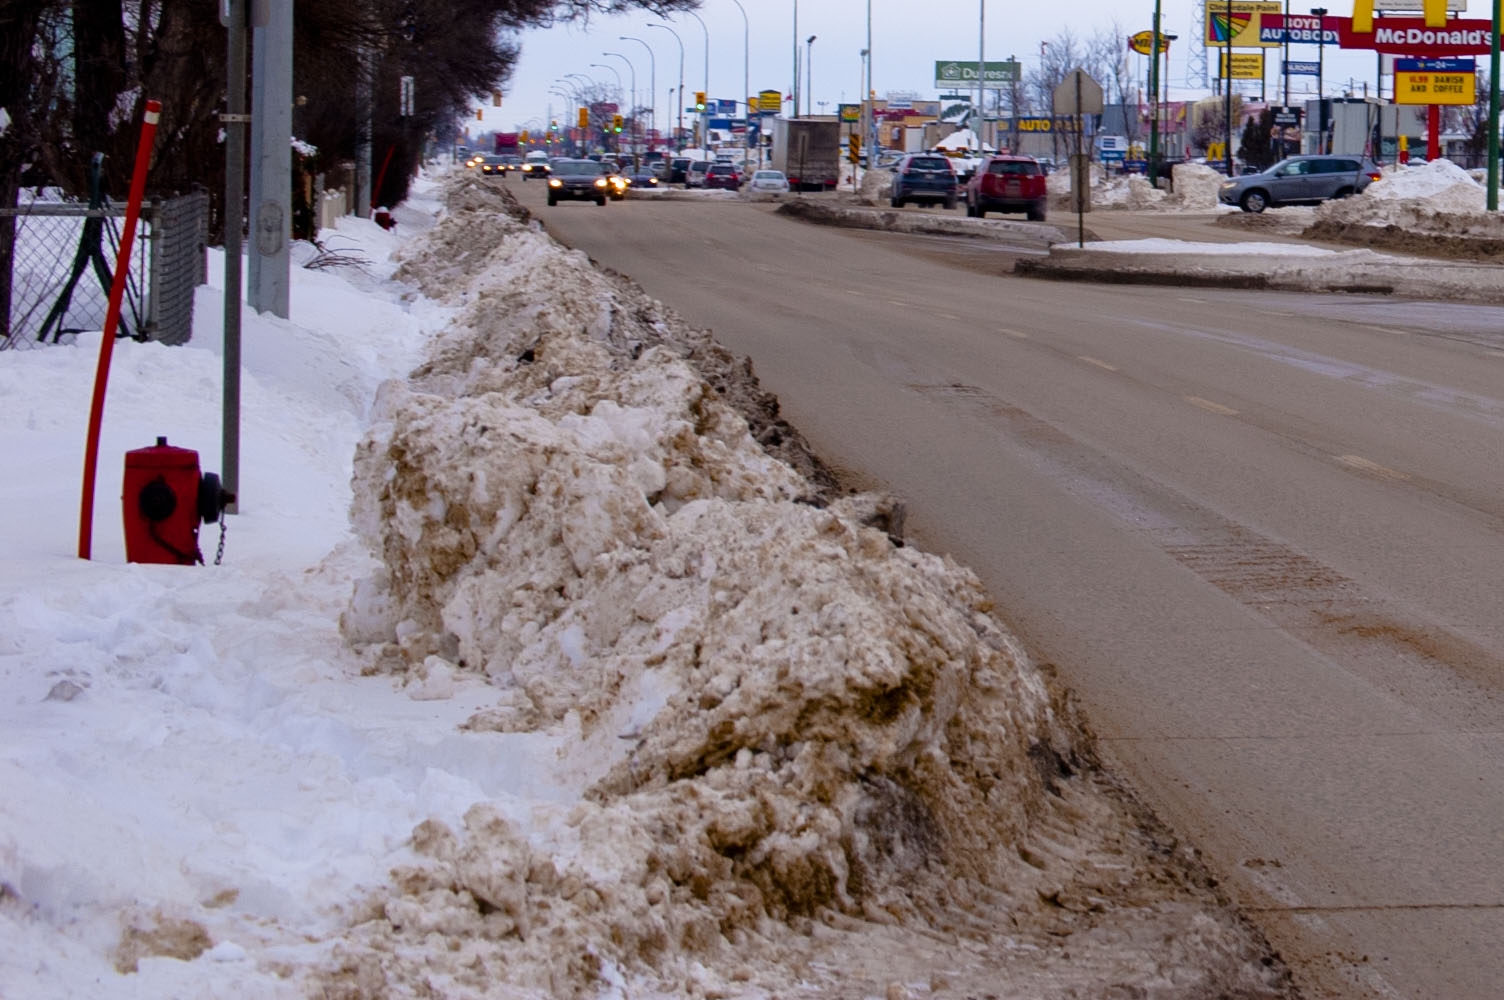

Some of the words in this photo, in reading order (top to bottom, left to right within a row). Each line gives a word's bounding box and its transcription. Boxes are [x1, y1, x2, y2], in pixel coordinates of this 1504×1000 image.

[1283, 18, 1320, 29] BOYD
[1375, 28, 1492, 46] McDonald's
[962, 67, 1014, 79] Duresne
[1410, 85, 1427, 93] AND
[1433, 85, 1464, 94] COFFEE
[1018, 119, 1051, 131] AUTO
